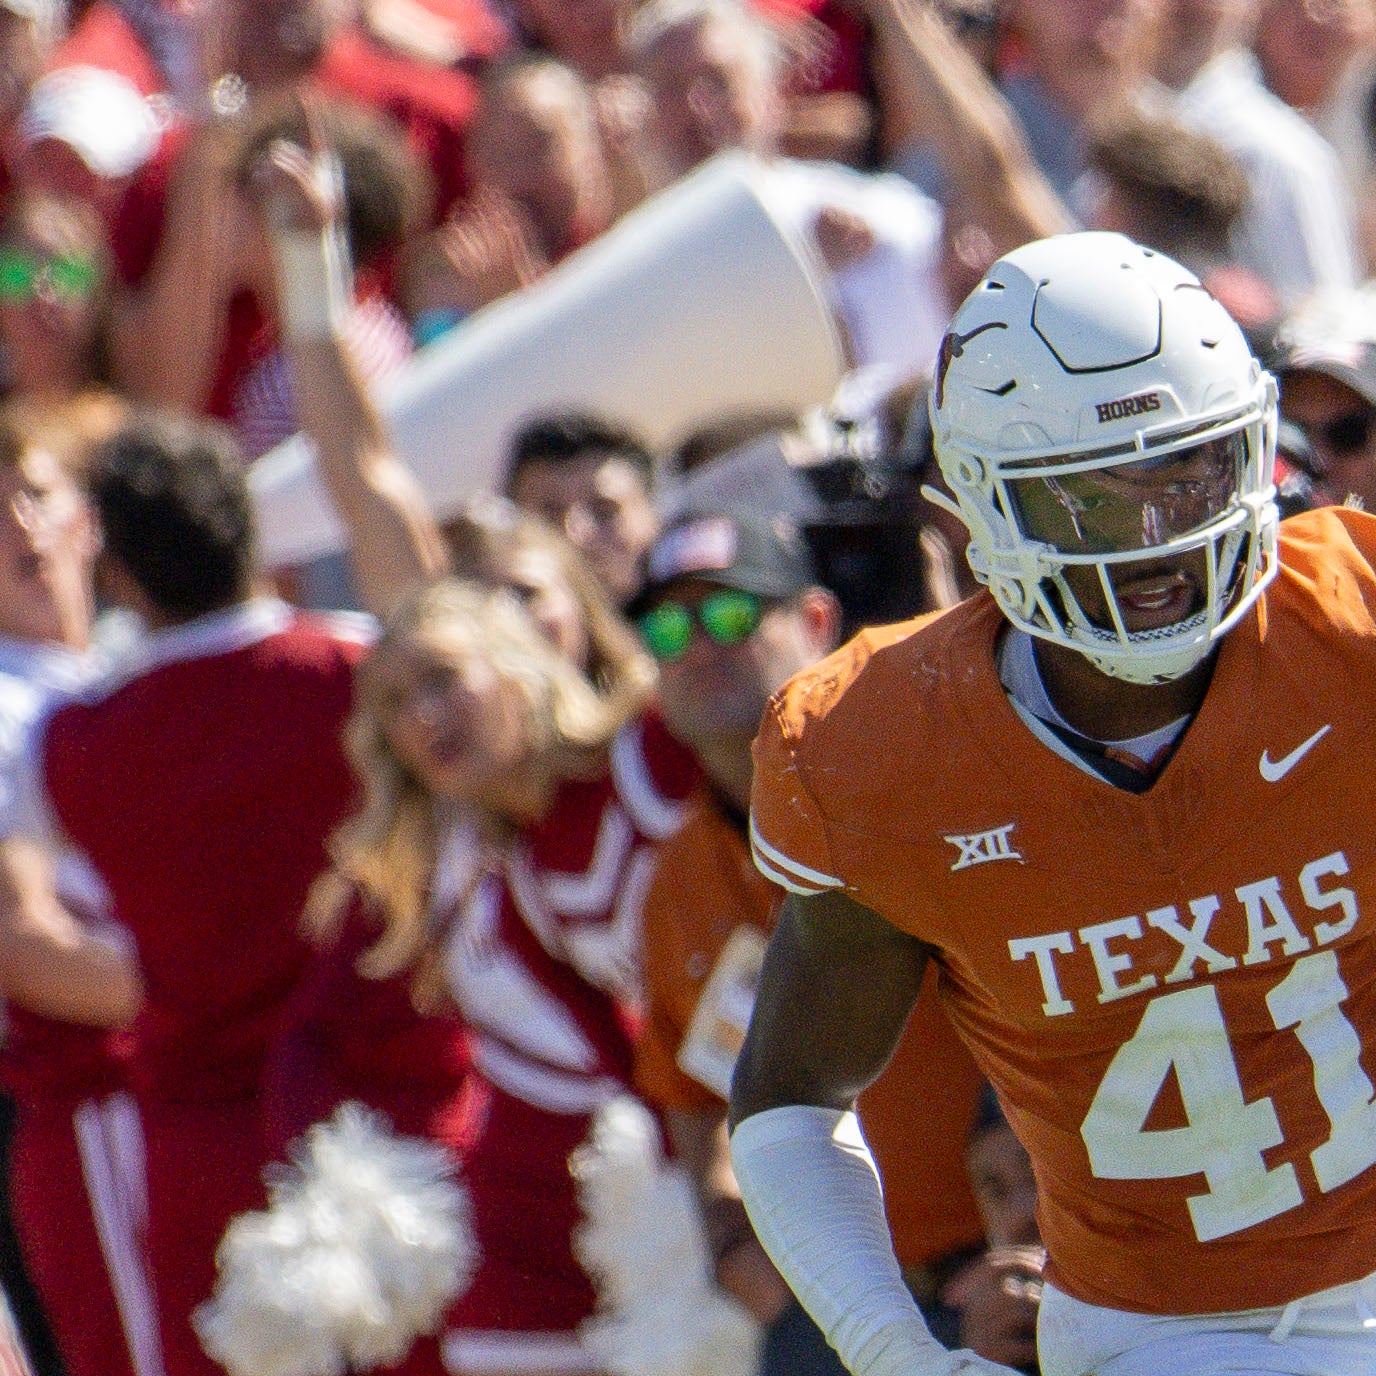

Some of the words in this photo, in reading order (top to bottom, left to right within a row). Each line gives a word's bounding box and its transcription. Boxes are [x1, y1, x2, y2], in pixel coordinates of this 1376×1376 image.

[1095, 392, 1161, 423] HORNS
[943, 823, 1022, 871] XII
[1008, 851, 1360, 1017] TEXAS
